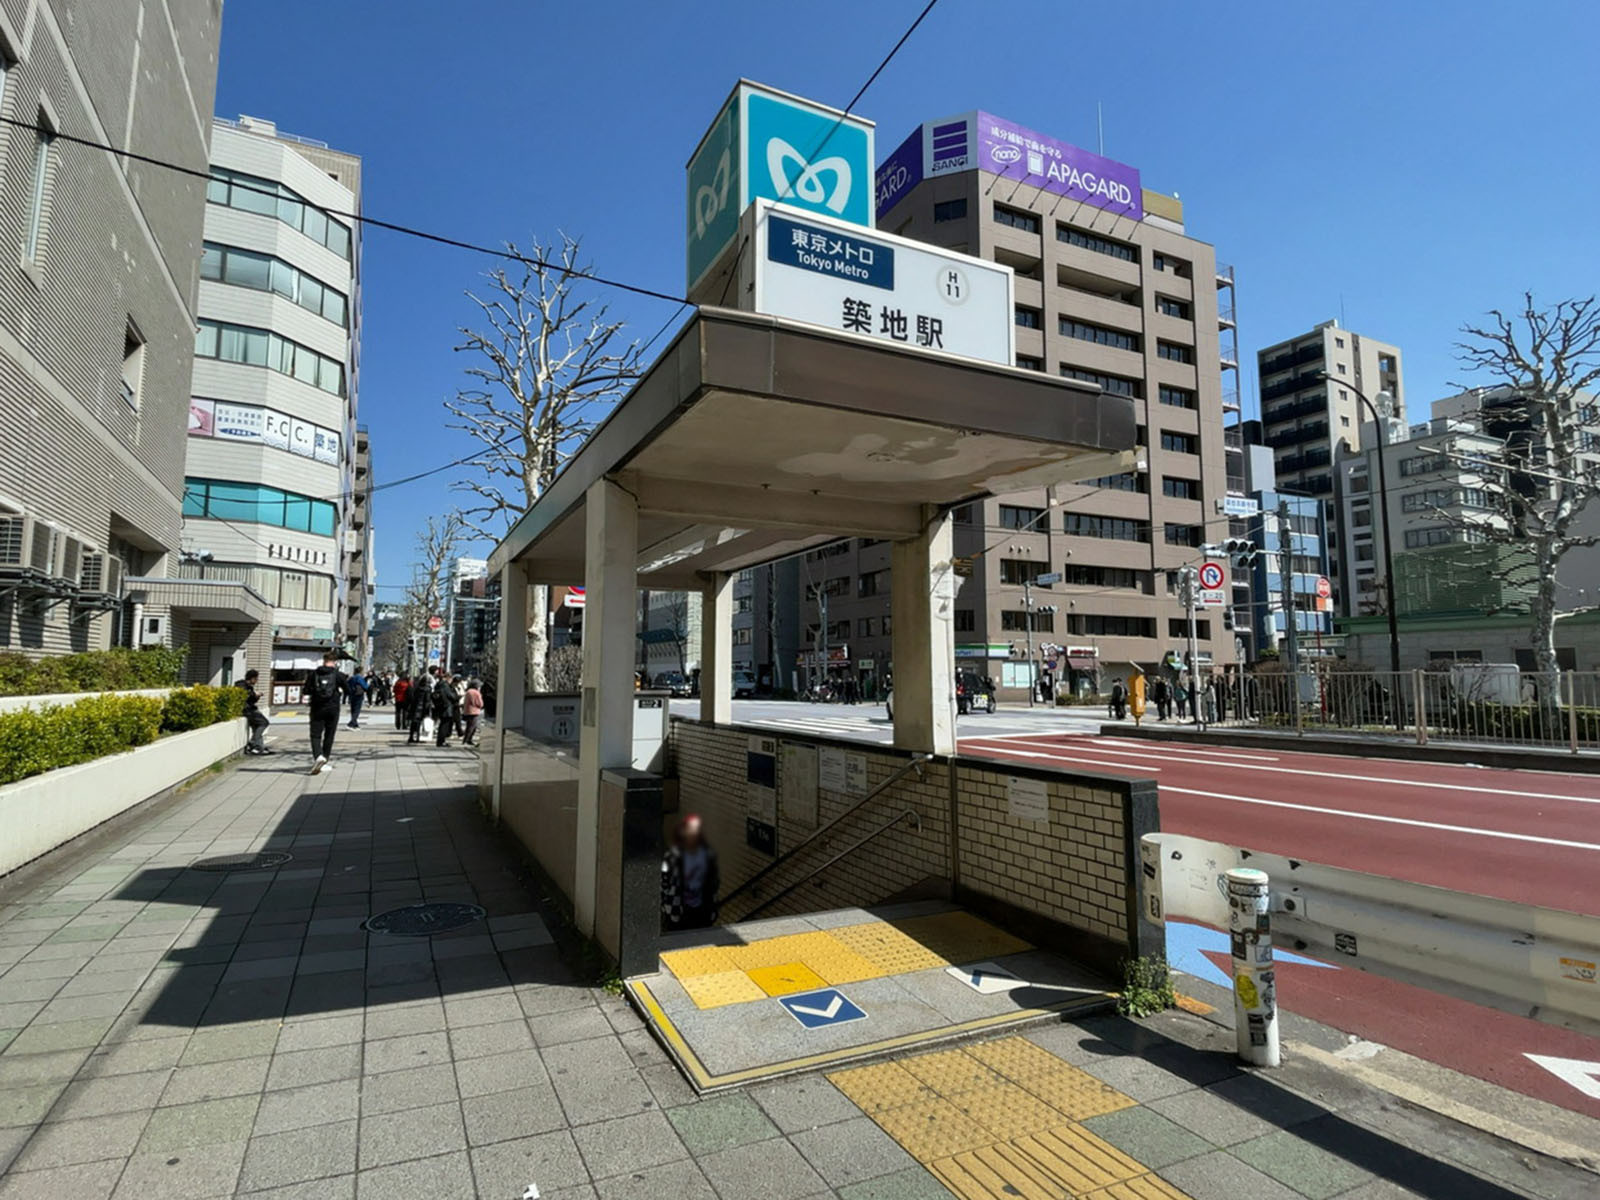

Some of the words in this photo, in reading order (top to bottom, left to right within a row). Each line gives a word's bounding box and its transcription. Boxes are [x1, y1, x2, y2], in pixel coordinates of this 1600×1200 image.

[994, 148, 1019, 160] nano
[791, 228, 874, 265] 東京メトロ
[797, 249, 832, 271] Tokyo
[834, 259, 869, 280] Metro
[948, 271, 957, 283] H
[946, 283, 960, 298] 11
[842, 297, 944, 349] 築地駅
